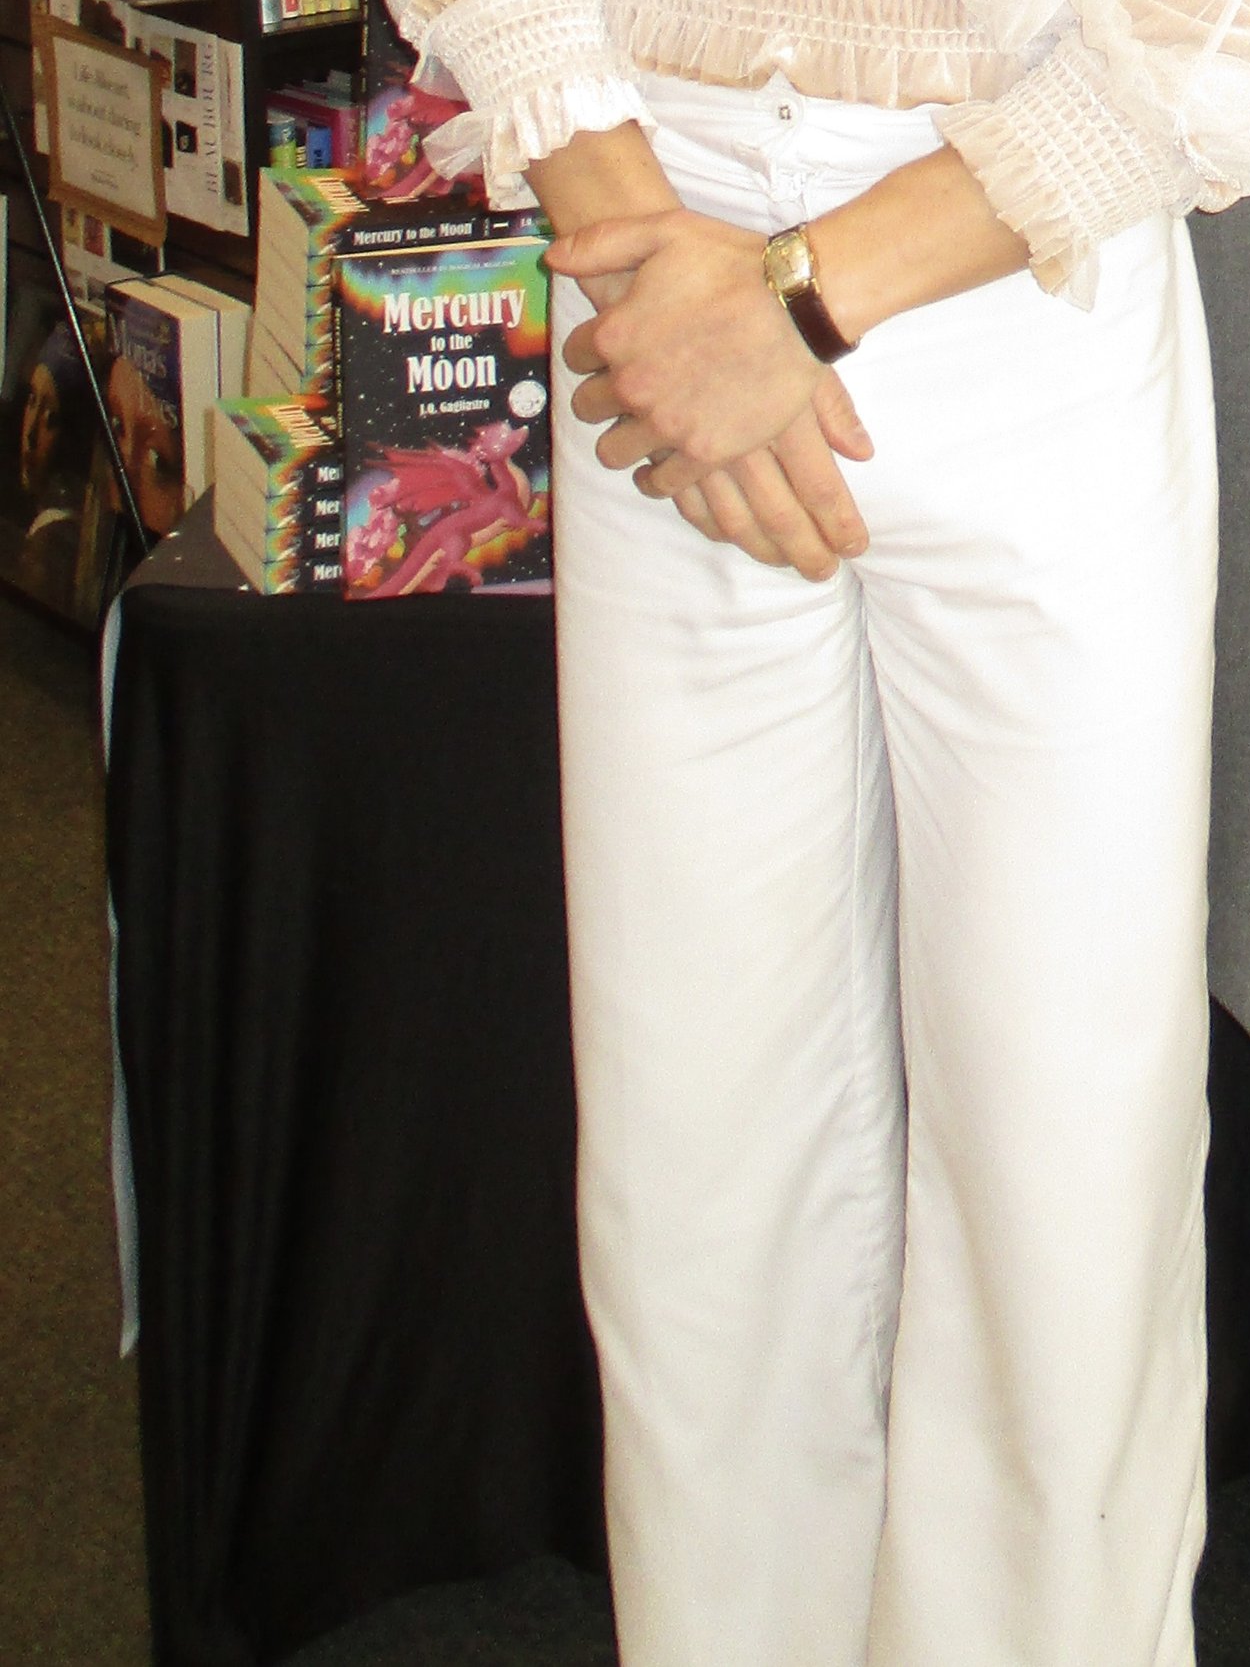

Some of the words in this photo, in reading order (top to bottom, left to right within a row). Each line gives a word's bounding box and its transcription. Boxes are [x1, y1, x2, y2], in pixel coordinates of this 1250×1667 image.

[353, 228, 402, 245] Mercury
[406, 229, 417, 240] to
[419, 227, 436, 239] the
[439, 221, 473, 238] Moon
[383, 288, 526, 334] Mercury
[430, 335, 446, 352] to
[450, 334, 473, 351] the
[407, 354, 498, 394] Moon
[440, 397, 491, 415] Gagliastro
